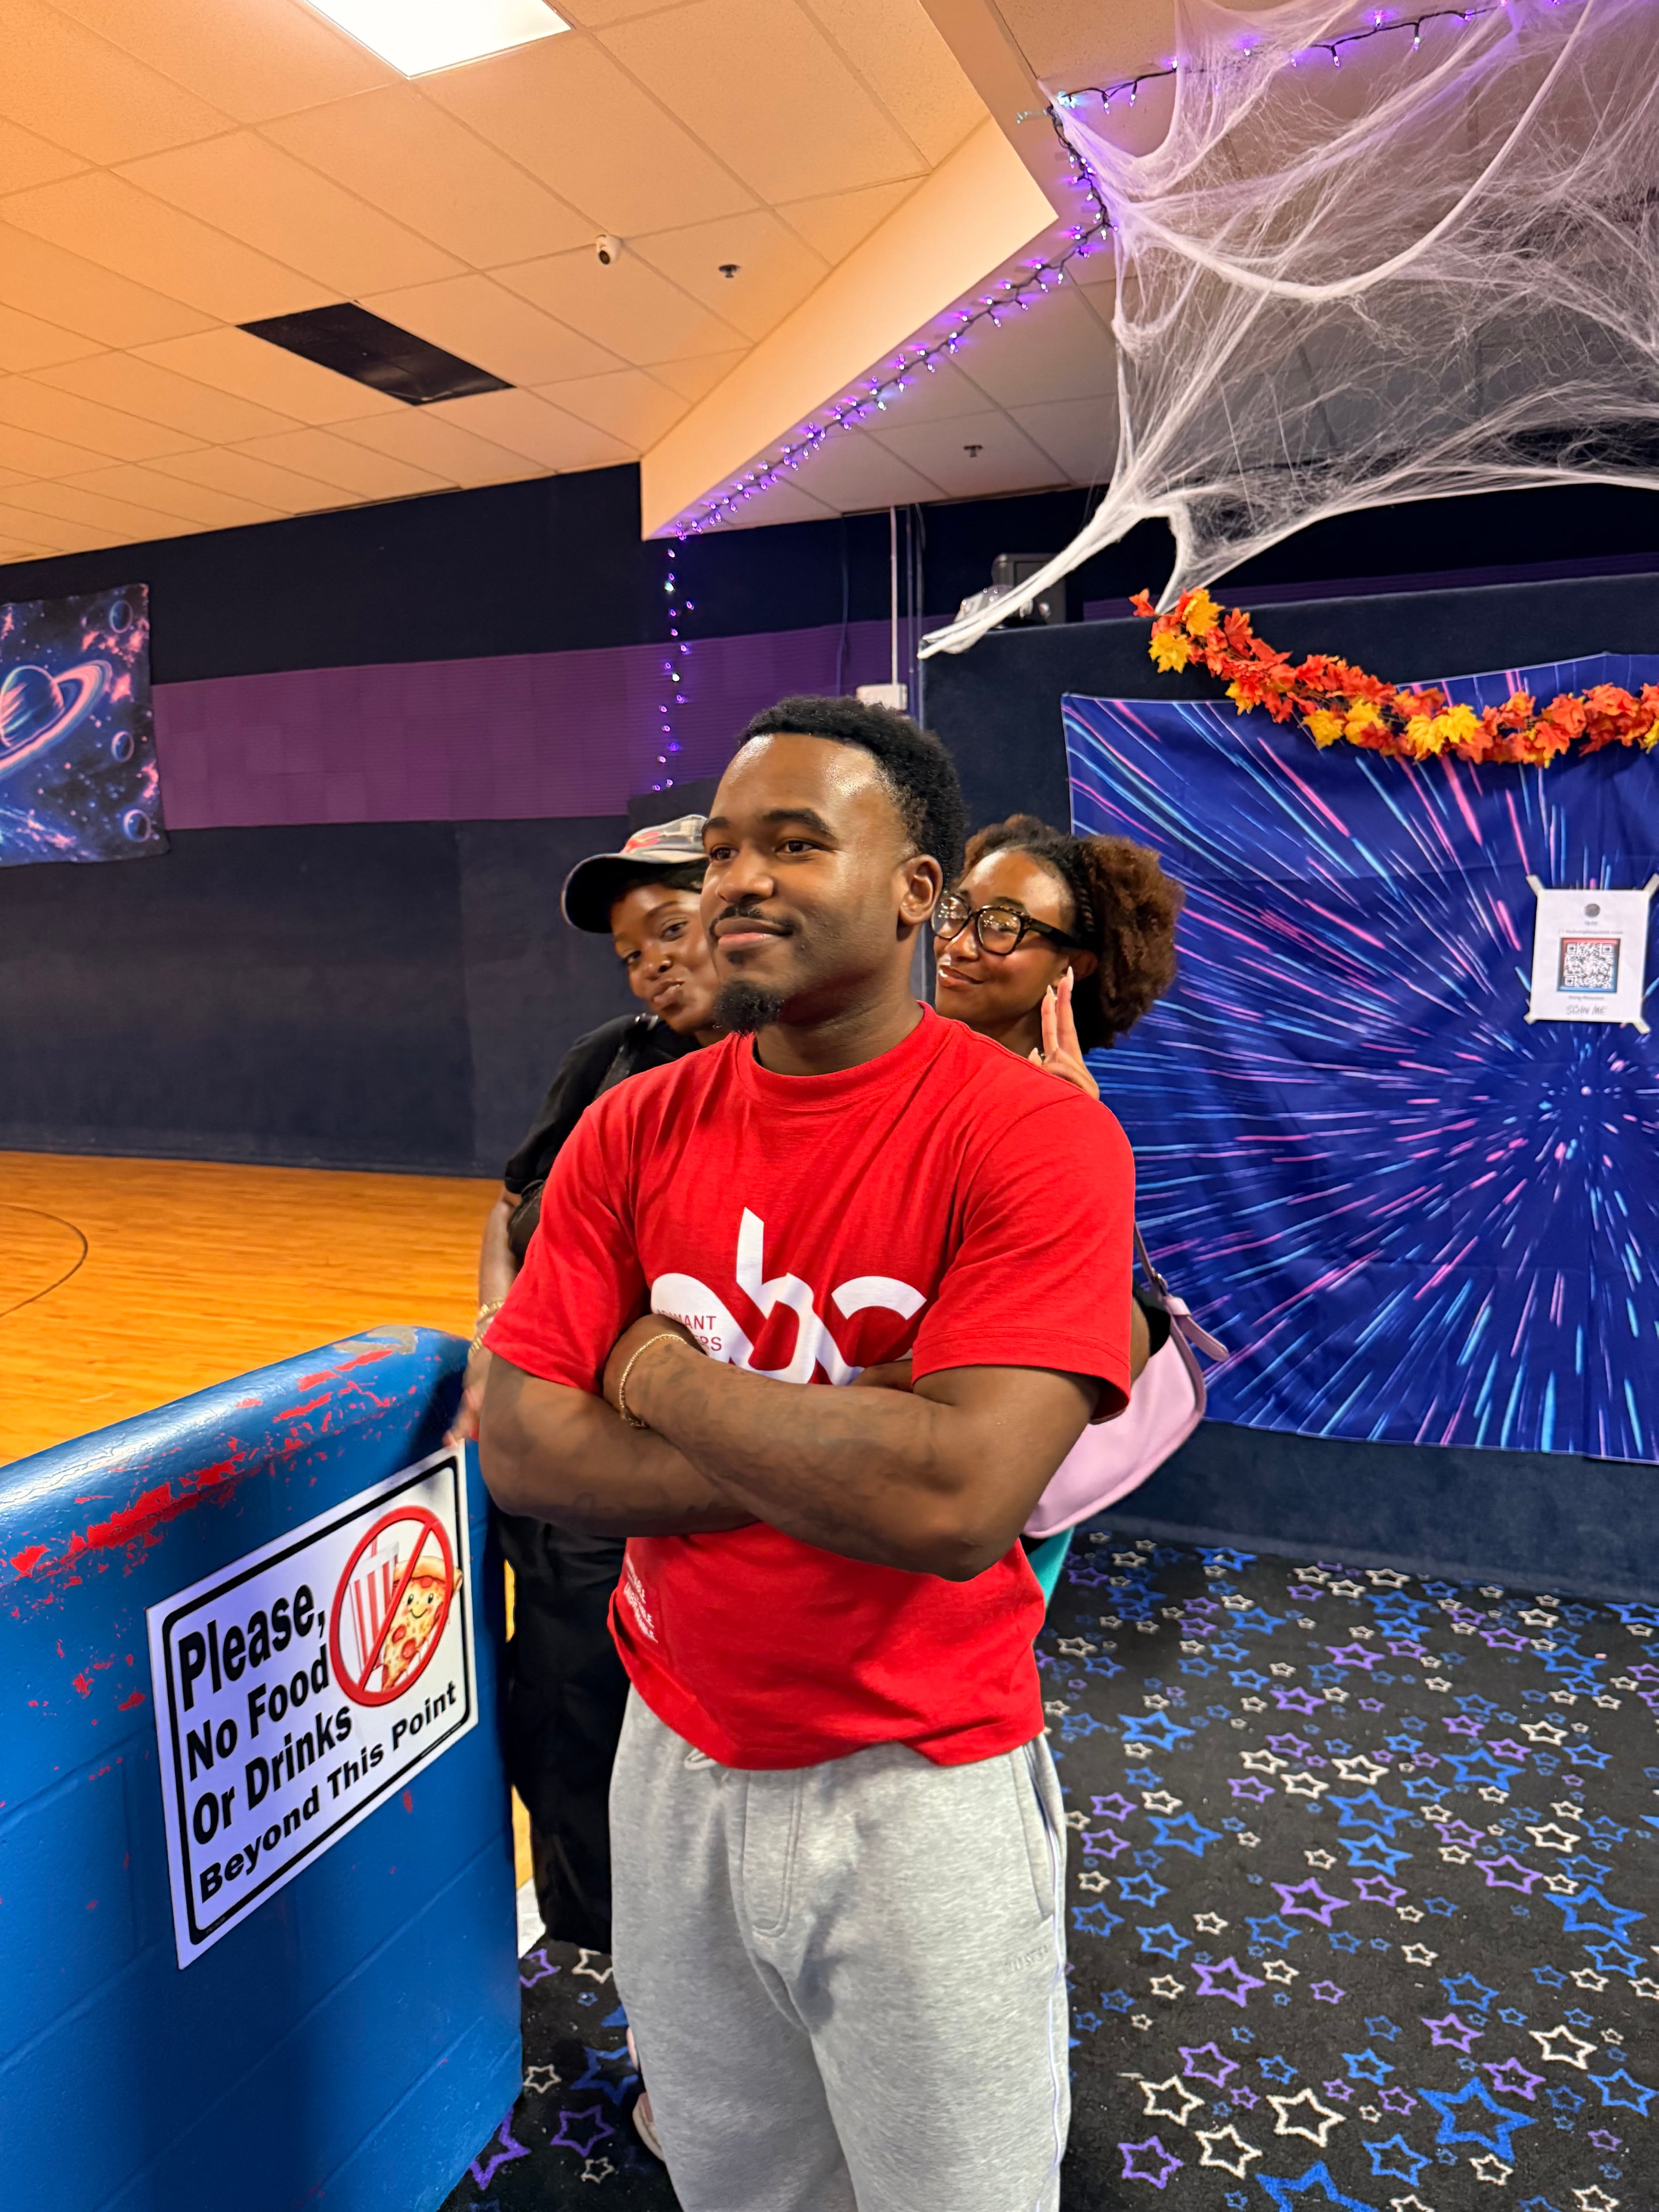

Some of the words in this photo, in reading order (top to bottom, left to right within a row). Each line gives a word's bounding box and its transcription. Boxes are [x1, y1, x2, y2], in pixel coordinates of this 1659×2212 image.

[1592, 1005, 1608, 1015] ME
[178, 1584, 325, 1712] Please,
[186, 1719, 238, 1781] No
[248, 1643, 329, 1739] Food
[193, 1786, 235, 1844] Or
[245, 1706, 352, 1810] Drinks
[199, 1785, 320, 1903] Beyond
[327, 1744, 384, 1799] This
[392, 1681, 456, 1751] Point
